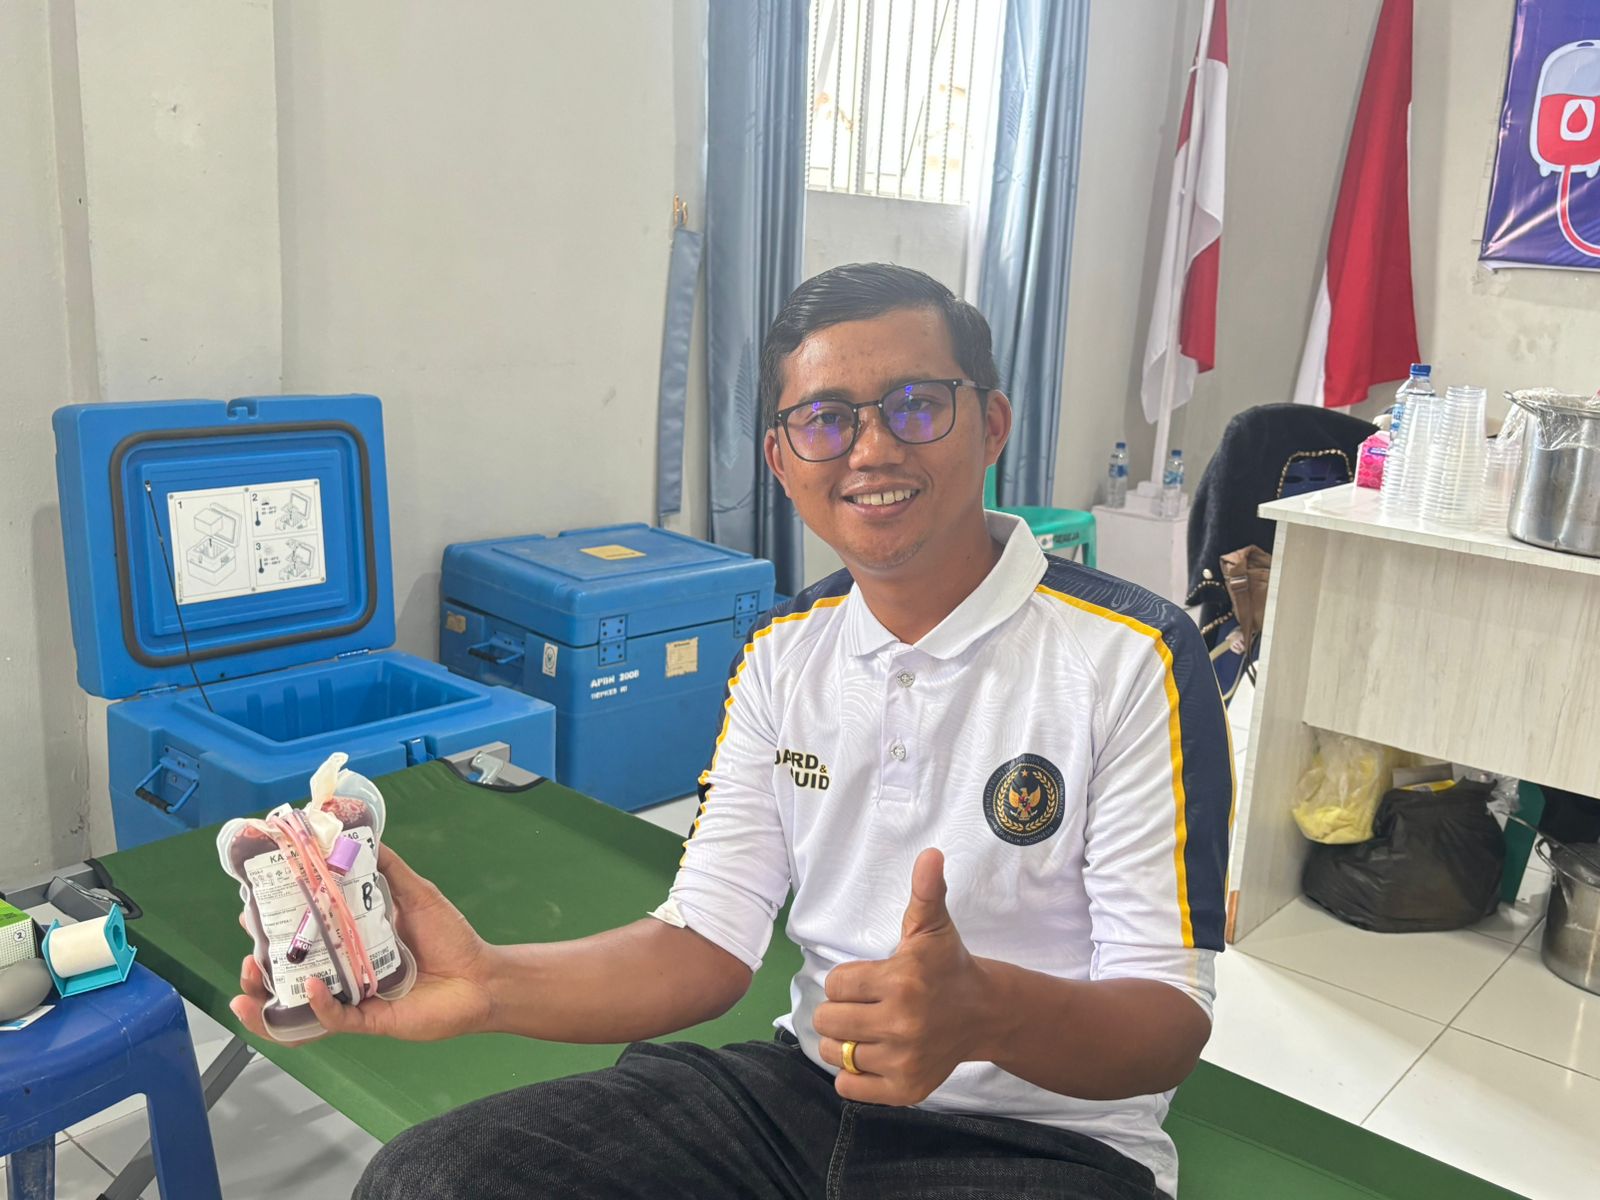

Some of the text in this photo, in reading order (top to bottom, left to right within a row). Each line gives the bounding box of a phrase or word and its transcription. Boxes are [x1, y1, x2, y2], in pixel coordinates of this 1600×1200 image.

[252, 493, 258, 502] 2
[178, 501, 183, 509] 1
[256, 542, 262, 551] 3
